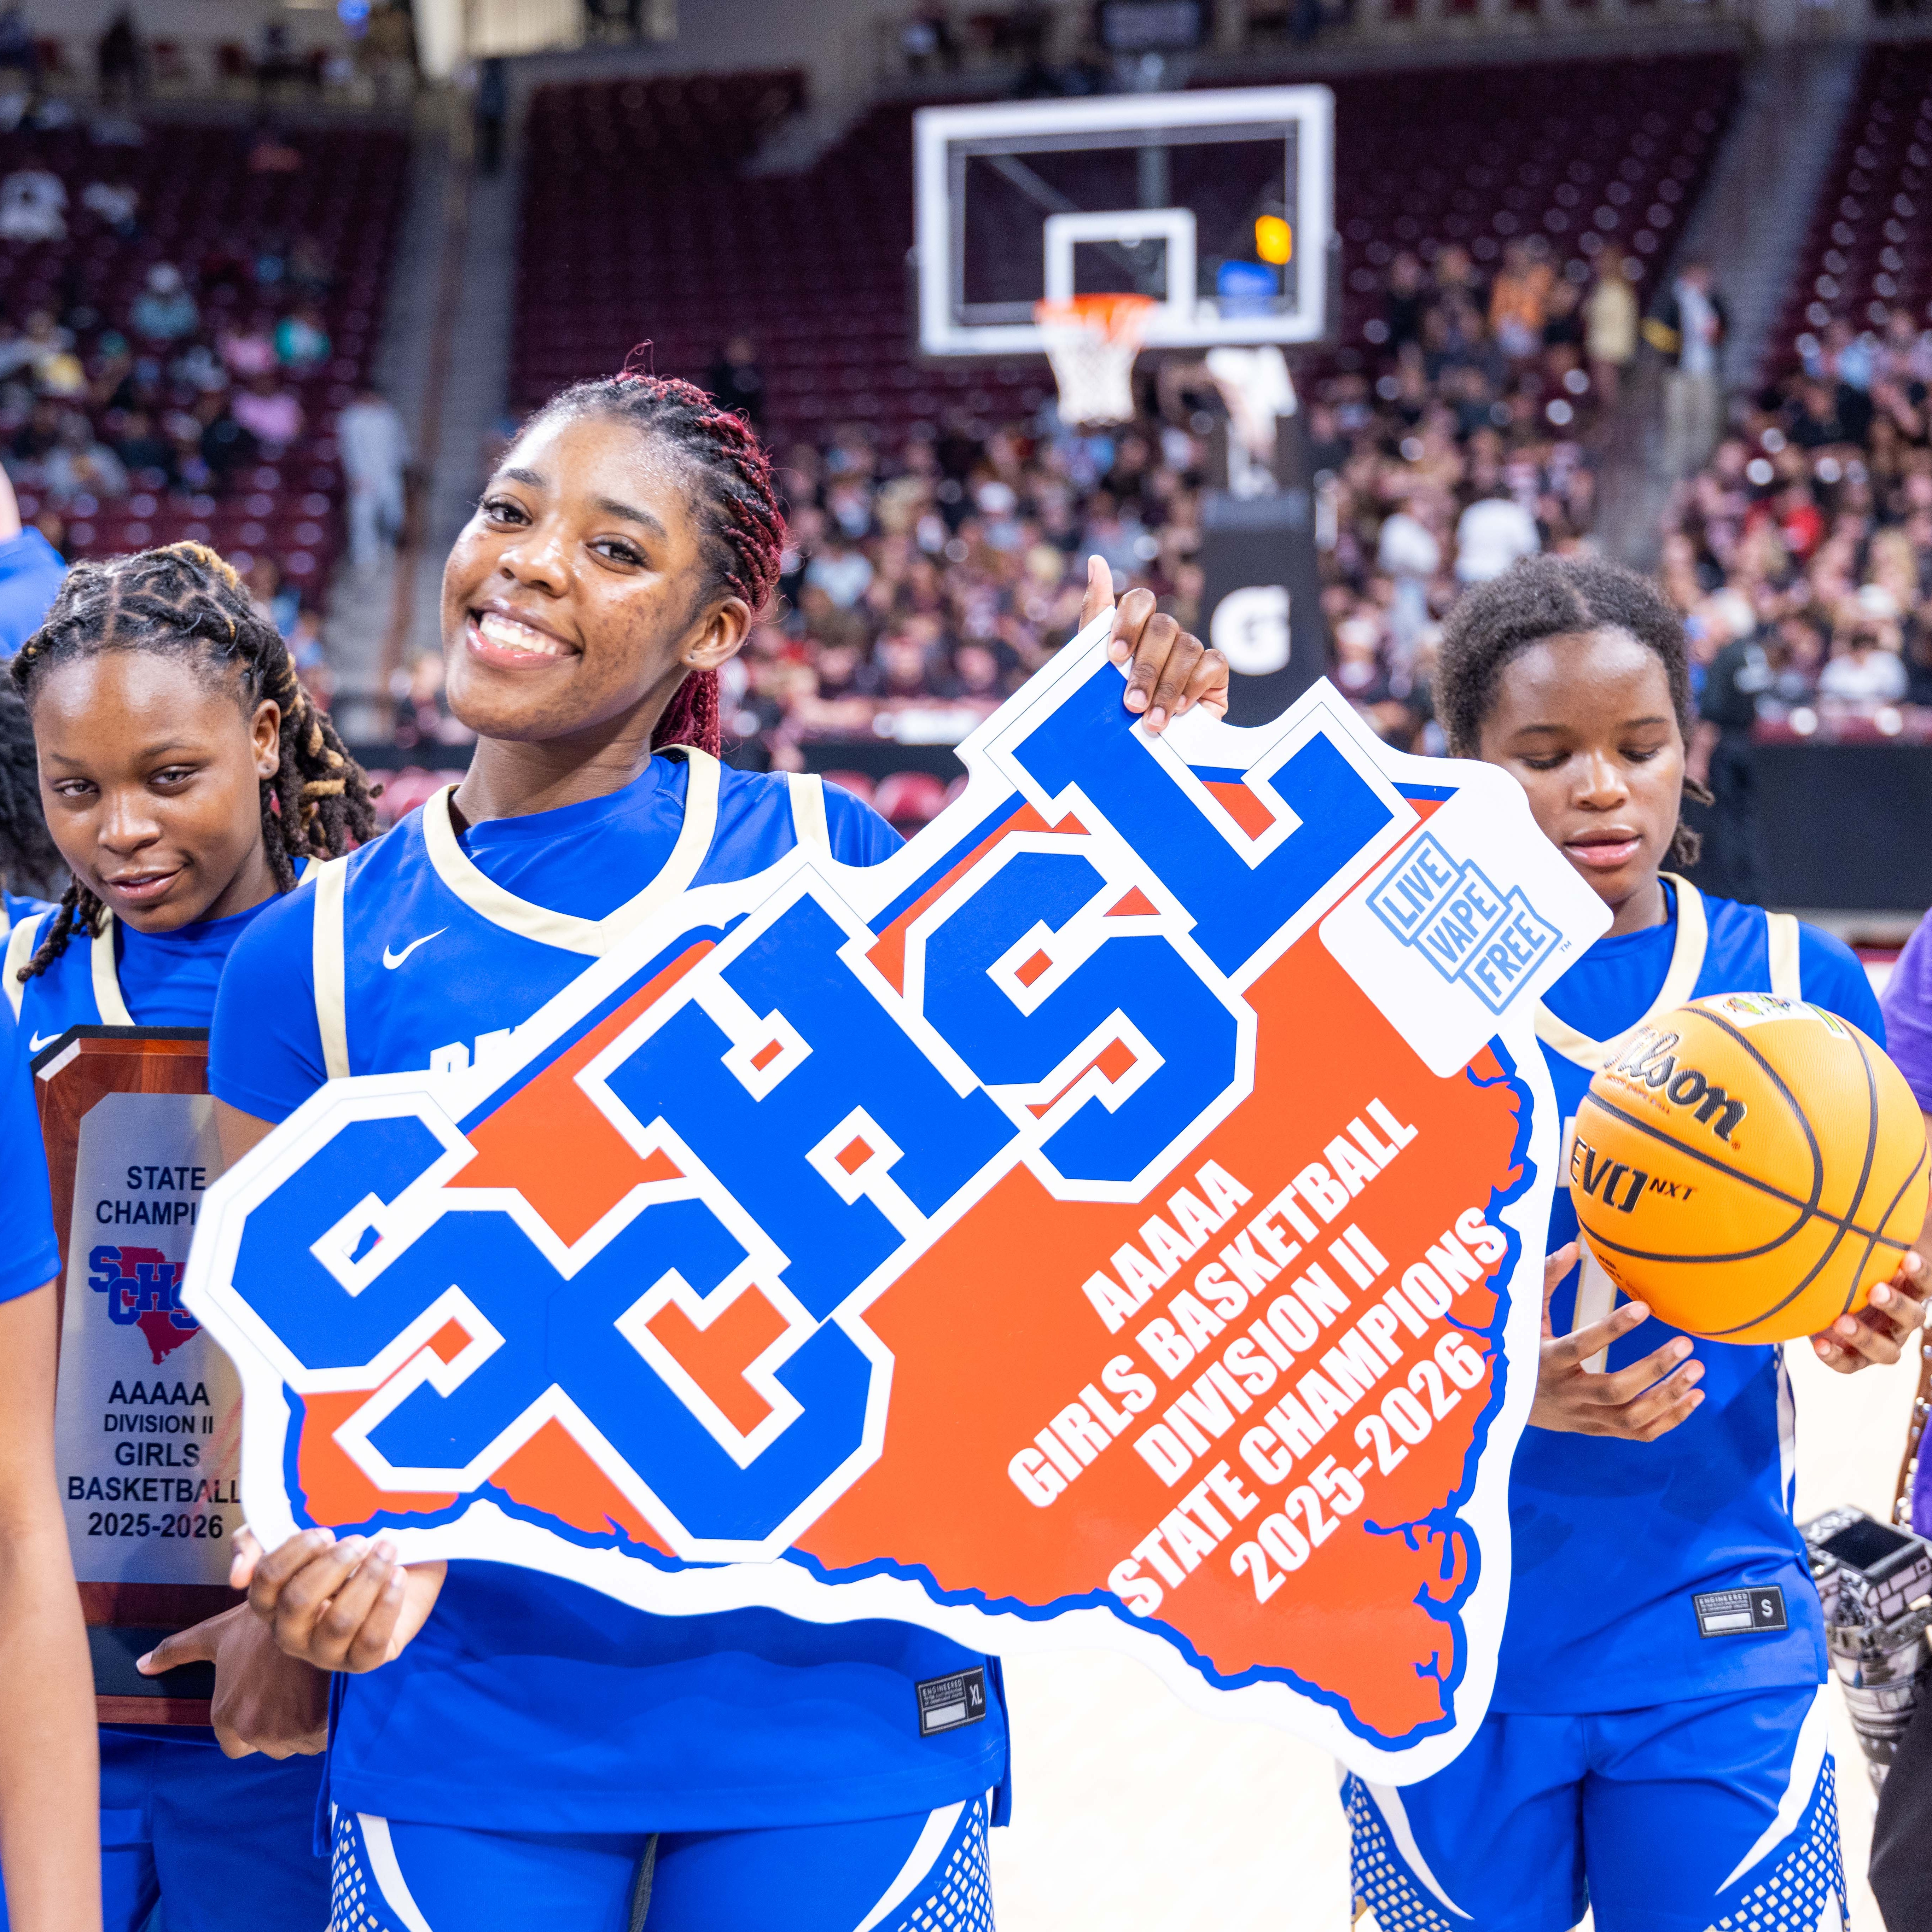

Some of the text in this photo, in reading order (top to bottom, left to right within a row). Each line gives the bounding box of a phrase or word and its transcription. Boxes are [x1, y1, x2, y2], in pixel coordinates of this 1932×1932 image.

[1382, 847, 1452, 930] LIVE
[1426, 882, 1499, 963] VAPE
[1474, 910, 1546, 998] FREE
[230, 661, 1395, 1541] SCHSL
[127, 1166, 205, 1190] STATE
[1649, 1177, 1698, 1201] NXT
[97, 1200, 196, 1225] CHAMPI
[1081, 1159, 1253, 1334] AAAAA
[1007, 1097, 1419, 1508] GIRLS BASKETBALL
[1133, 1222, 1390, 1488] DIVISION II
[108, 1380, 210, 1406] AAAAA
[104, 1414, 213, 1433] DIVISION II
[1107, 1207, 1507, 1618] STATE CHAMPIONS
[115, 1442, 200, 1467] GIRLS
[1230, 1331, 1486, 1604] 2025-2026
[68, 1476, 241, 1503] BASKETBALL
[88, 1512, 223, 1538] 2025-2026
[1699, 1593, 1747, 1605] ENGINEERED
[1761, 1599, 1773, 1618] S
[923, 1679, 962, 1697] ENGINEERED
[970, 1683, 982, 1706] XL
